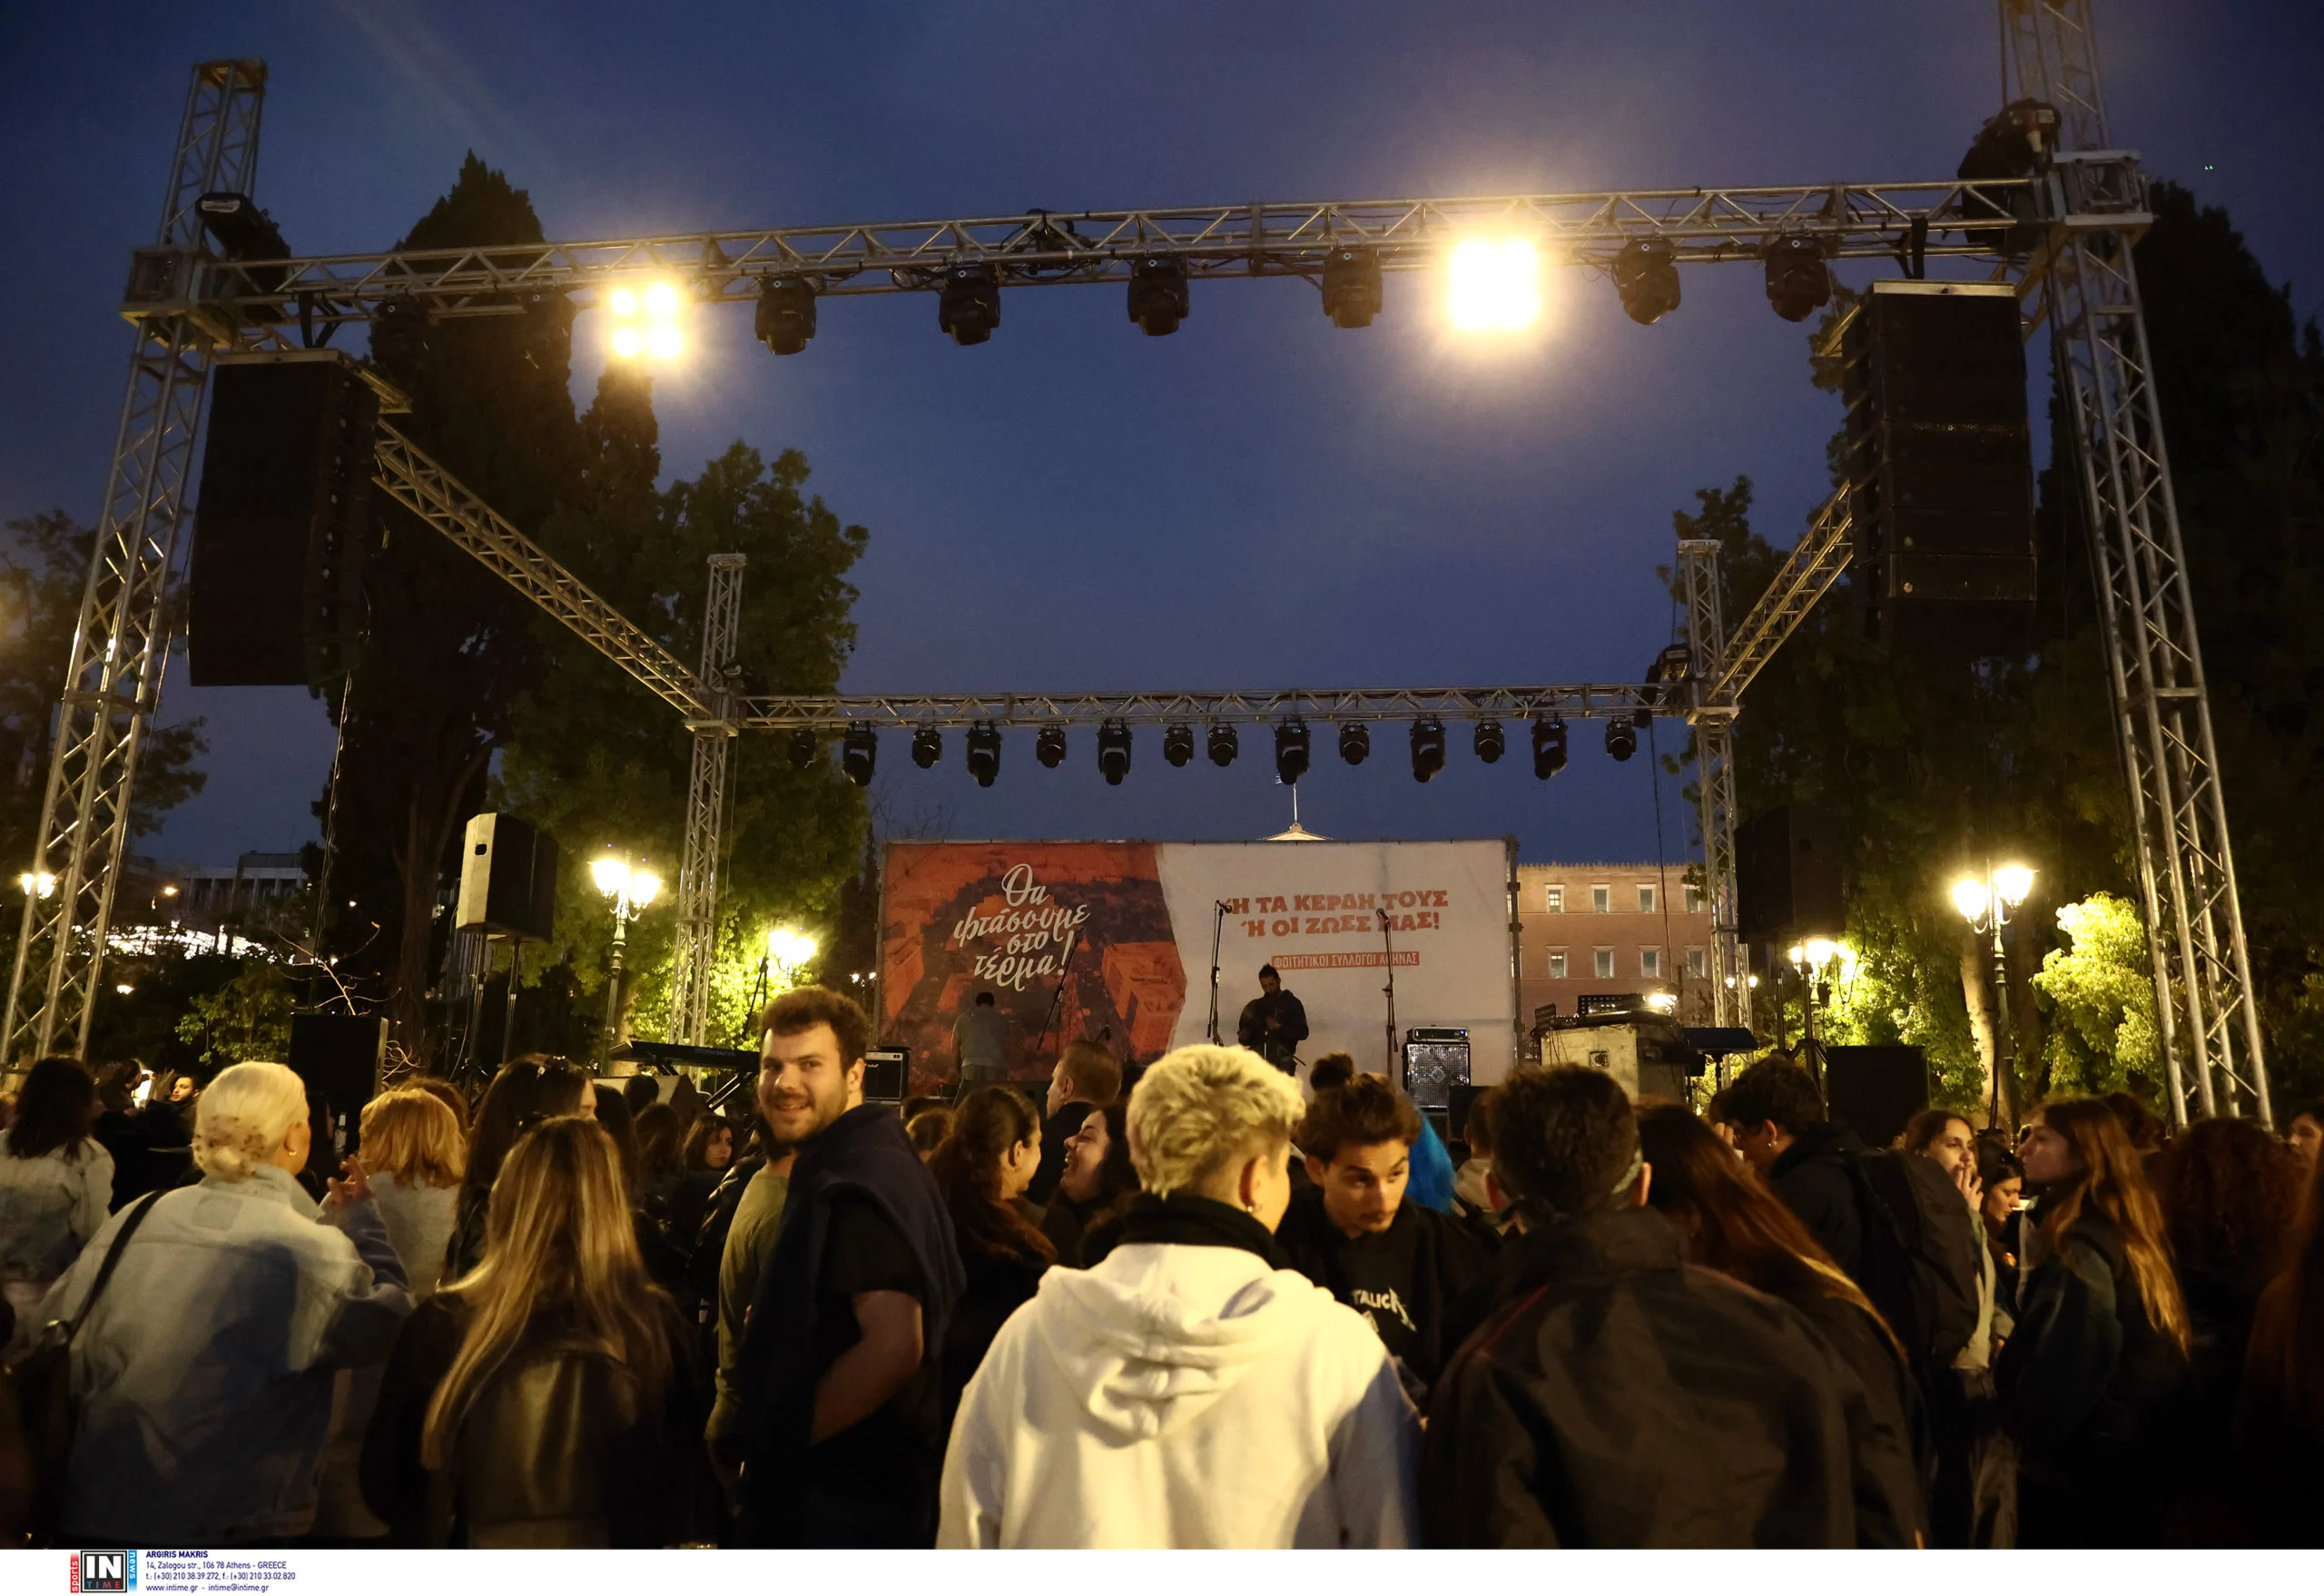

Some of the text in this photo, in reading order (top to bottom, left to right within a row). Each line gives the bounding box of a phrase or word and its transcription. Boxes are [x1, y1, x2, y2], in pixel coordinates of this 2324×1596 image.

[1001, 863, 1050, 907] Θα
[1256, 895, 1288, 913] ΤΑ
[1294, 893, 1375, 911] ΚΕΡΔΗ
[1381, 890, 1449, 911] ΤΟΥΣ
[953, 904, 1091, 948] φτάσουμε
[1272, 916, 1299, 937] ΟΙ
[1305, 915, 1372, 934] ΖΩΕΣ
[1377, 911, 1440, 932] ΜΑΣ!
[1007, 931, 1049, 955] στο
[973, 930, 1075, 992] τέρμα!
[1274, 954, 1329, 969] ΦΟΙΤΗΤΙΚΟΙ
[1331, 953, 1377, 967] ΣΥΛΛΟΓΟΙ
